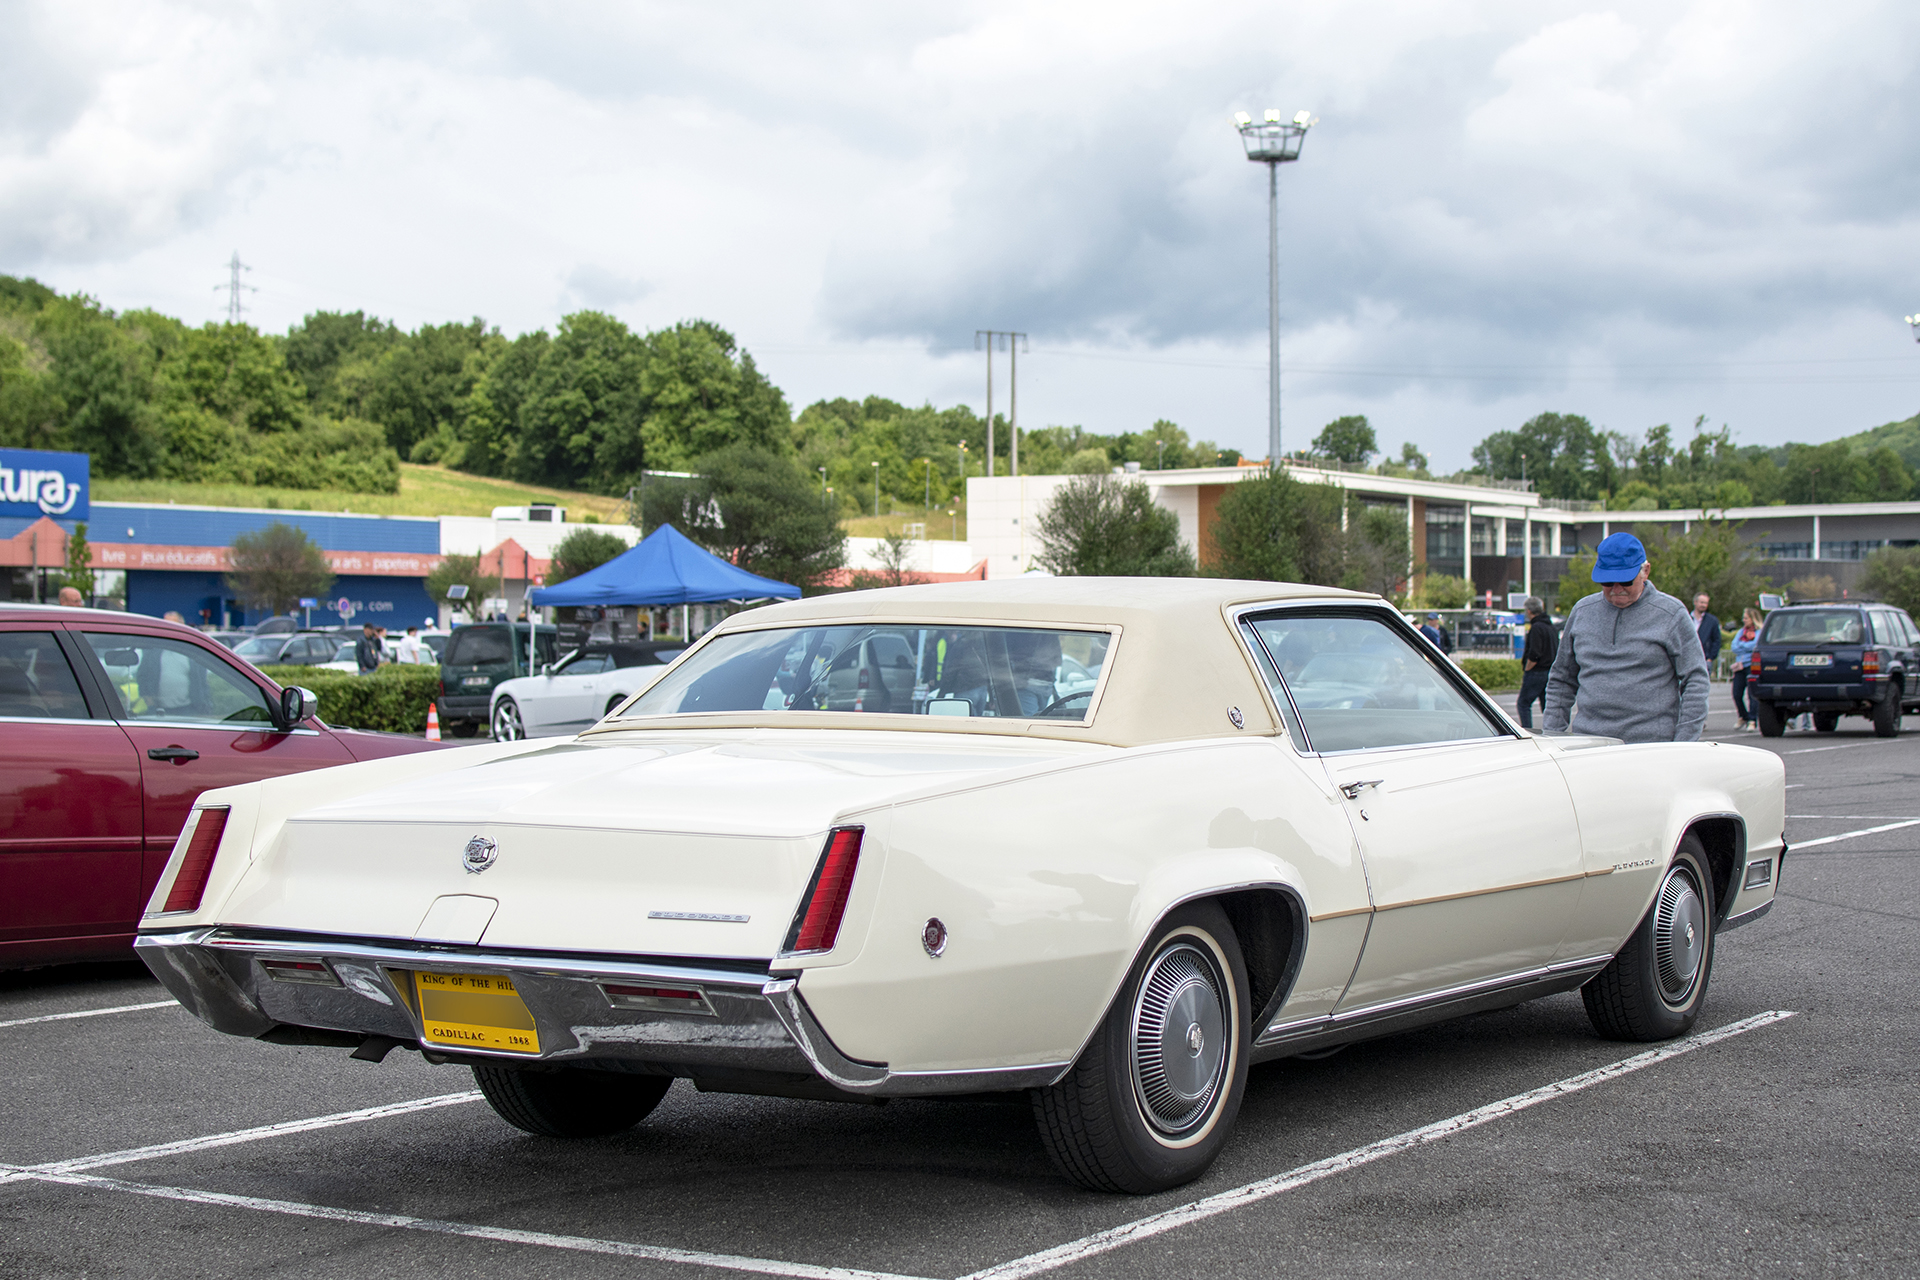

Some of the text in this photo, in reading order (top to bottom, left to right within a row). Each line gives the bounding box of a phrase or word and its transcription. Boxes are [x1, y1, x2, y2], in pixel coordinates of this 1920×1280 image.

[102, 549, 127, 564] livre
[373, 558, 420, 571] papeterie
[422, 974, 445, 985] KING
[451, 977, 463, 986] OF
[469, 978, 490, 988] THE
[432, 1027, 486, 1041] CADILLAC
[508, 1035, 530, 1046] 1968
